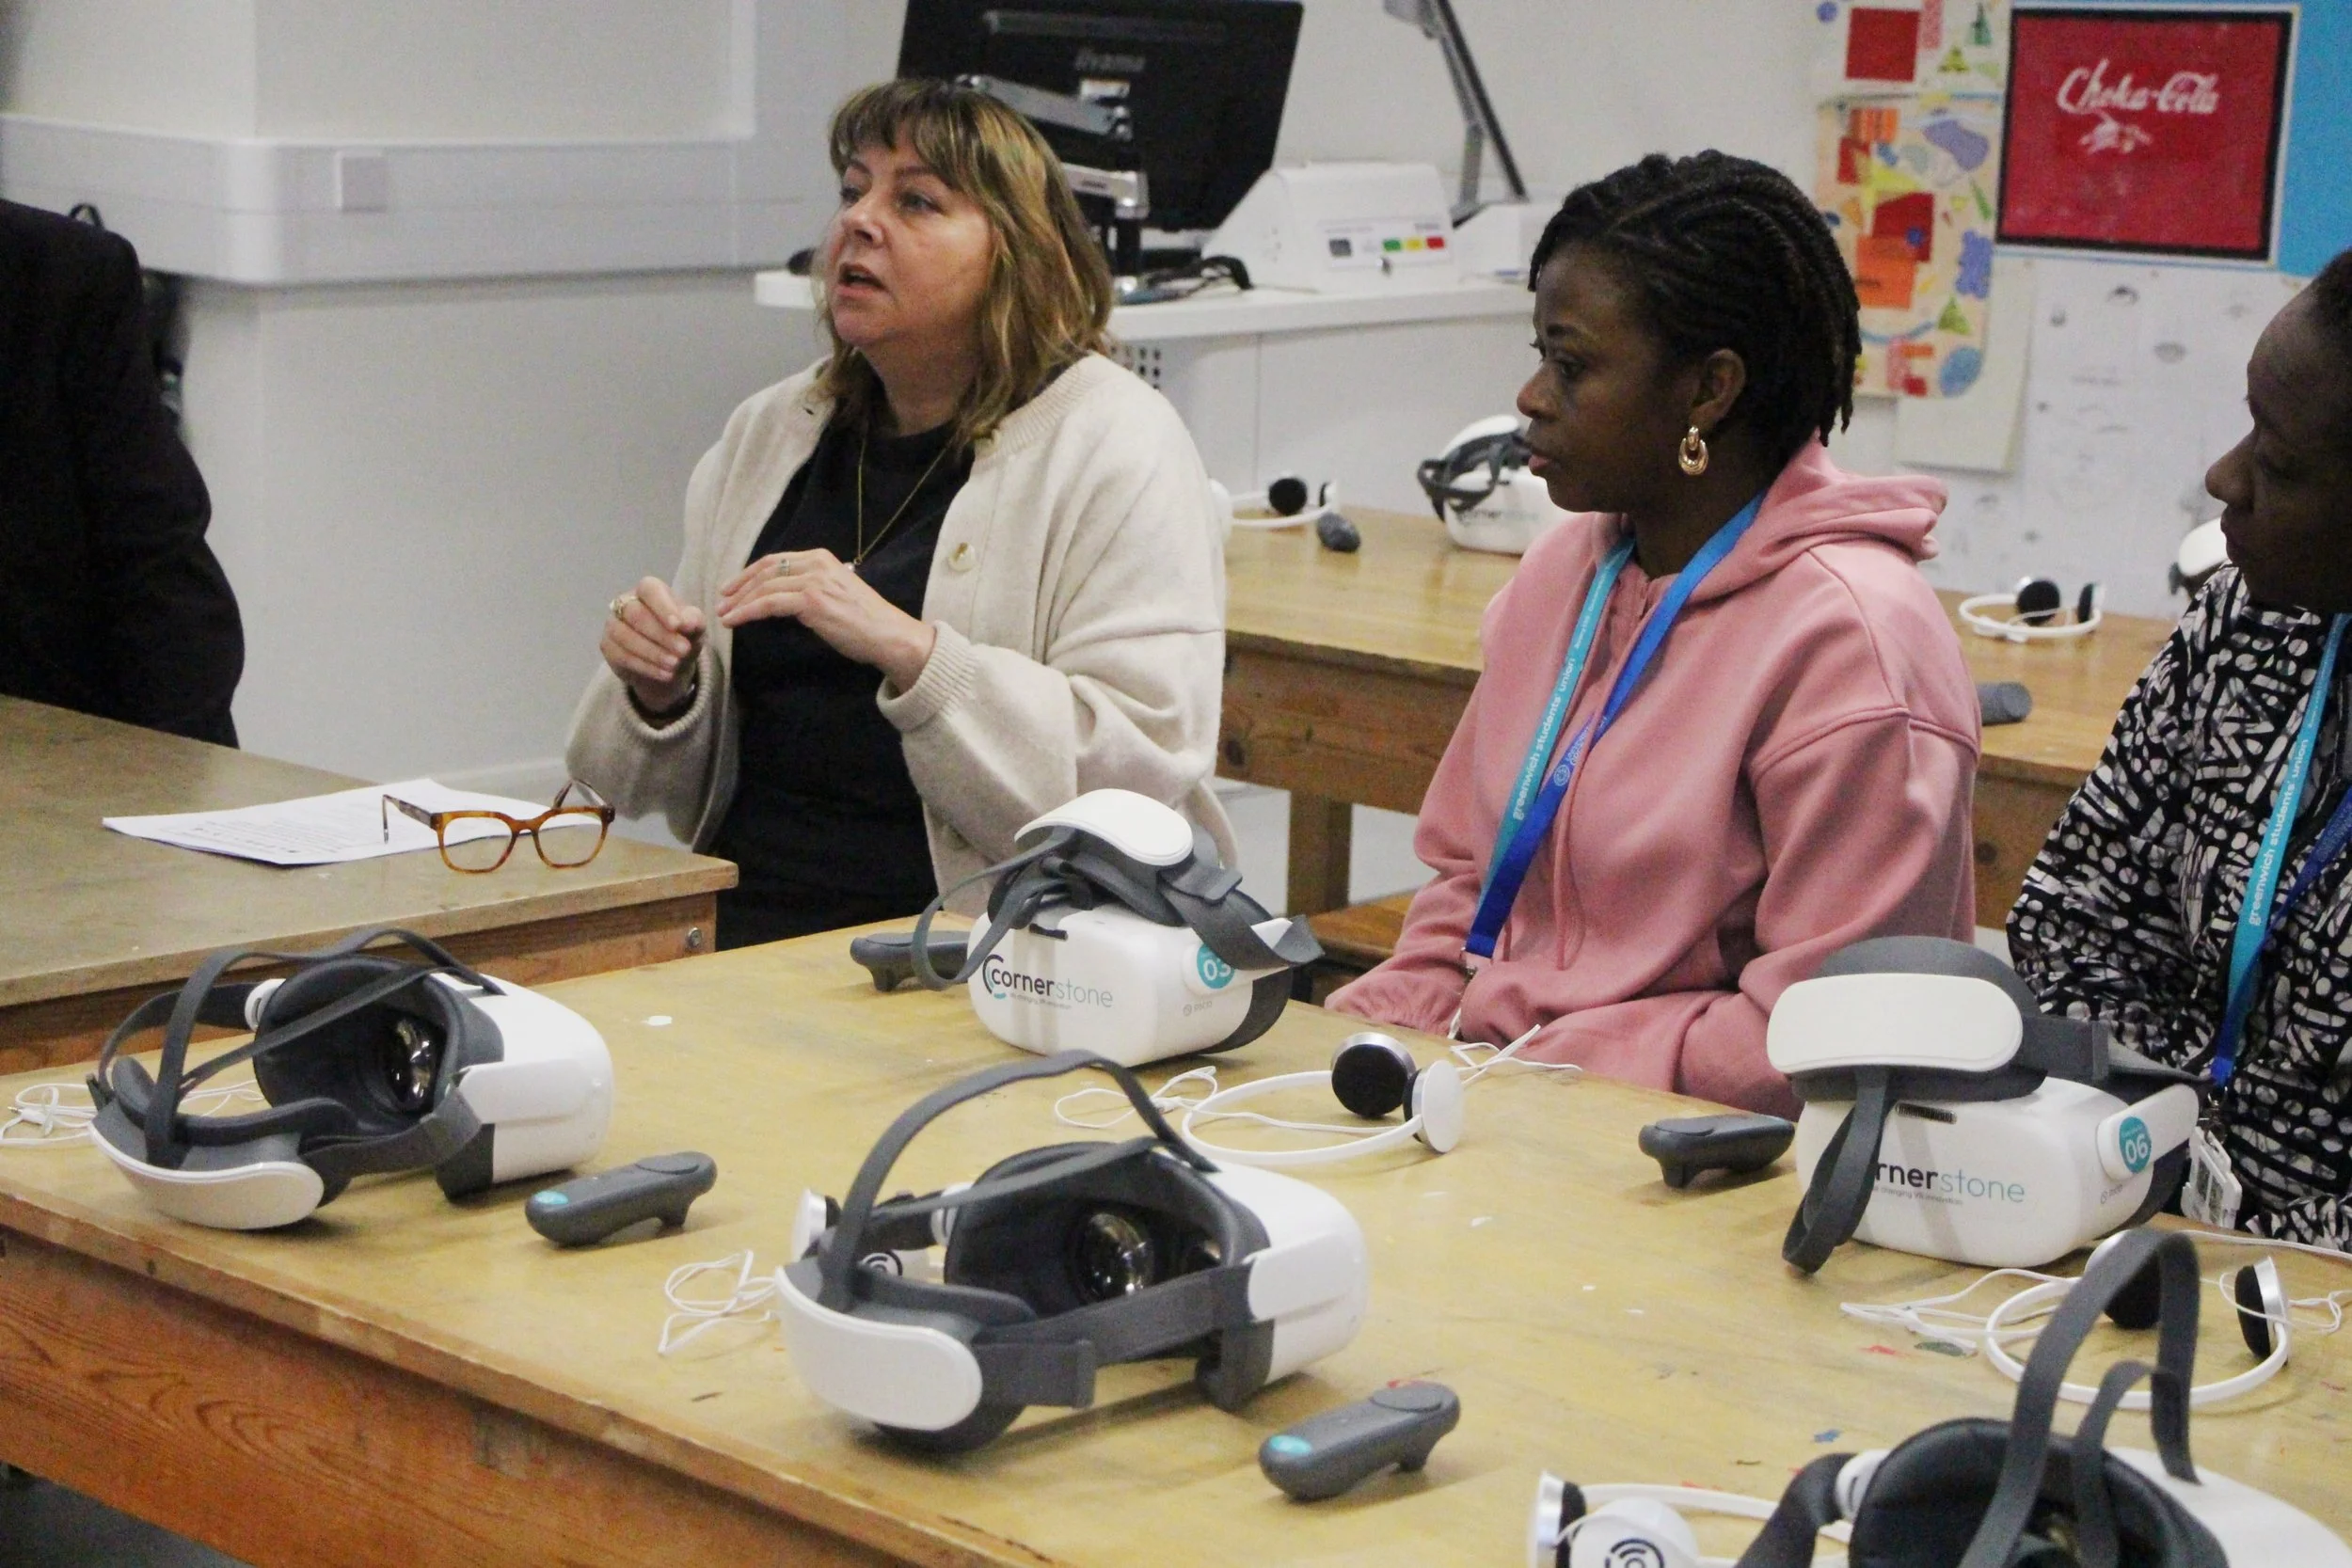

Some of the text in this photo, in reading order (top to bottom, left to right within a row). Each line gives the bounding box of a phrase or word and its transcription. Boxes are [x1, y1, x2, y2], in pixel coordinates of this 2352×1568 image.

[1513, 752, 1540, 821] greenwich
[1559, 657, 1576, 693] union
[2249, 738, 2309, 927] greenwich students' union
[991, 968, 1114, 1008] cornerstone
[2125, 1132, 2148, 1164] 06
[1875, 1162, 2026, 1203] rnerstone
